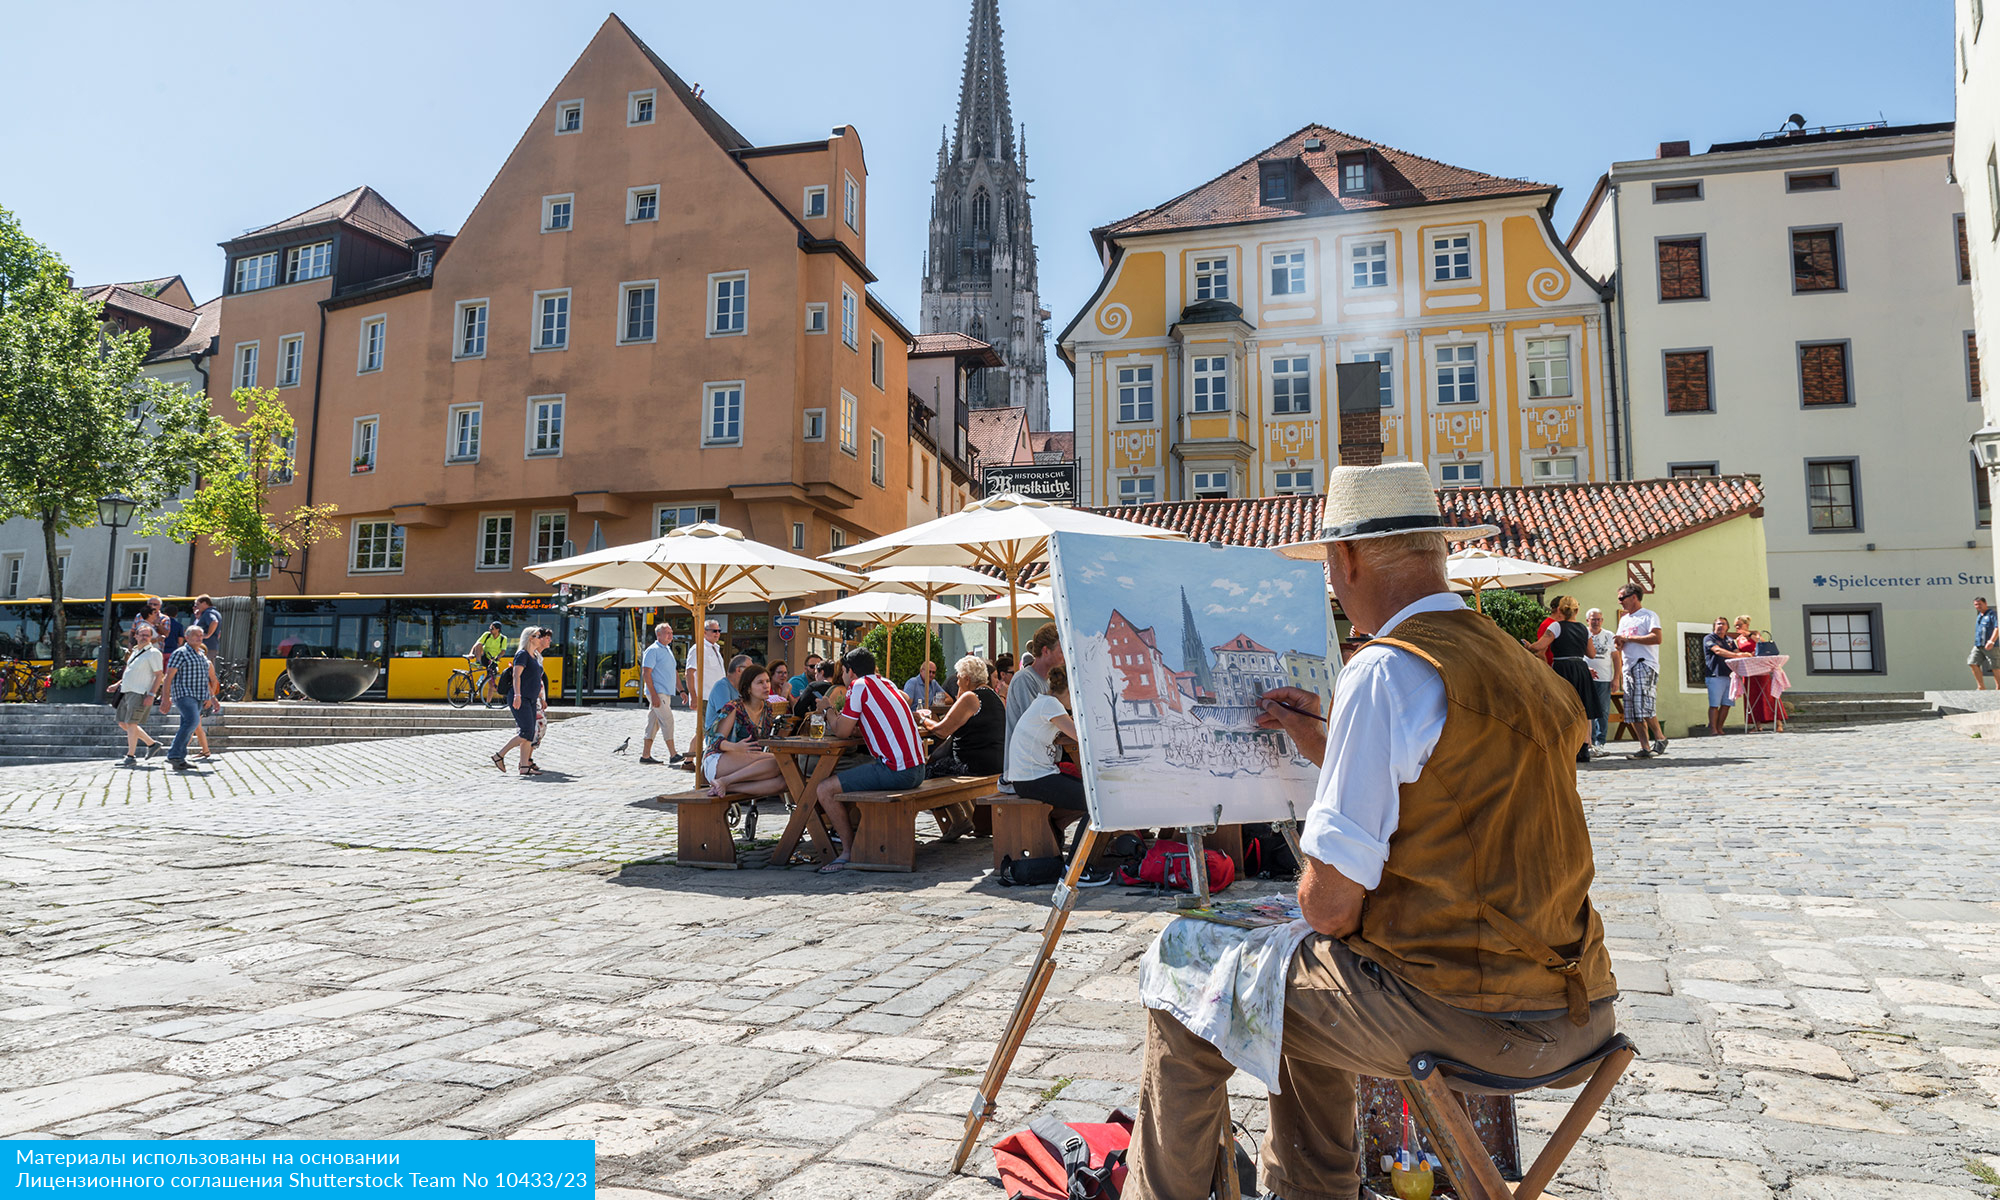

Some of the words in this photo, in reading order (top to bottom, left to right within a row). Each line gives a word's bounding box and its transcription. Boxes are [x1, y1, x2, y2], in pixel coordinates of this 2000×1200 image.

[1014, 471, 1065, 480] HISTORISCHE
[986, 469, 1072, 498] Wurstküche
[1829, 574, 1921, 591] Spielcenter
[1926, 576, 1953, 586] am
[1958, 572, 1994, 586] Stru
[472, 599, 489, 610] 2A
